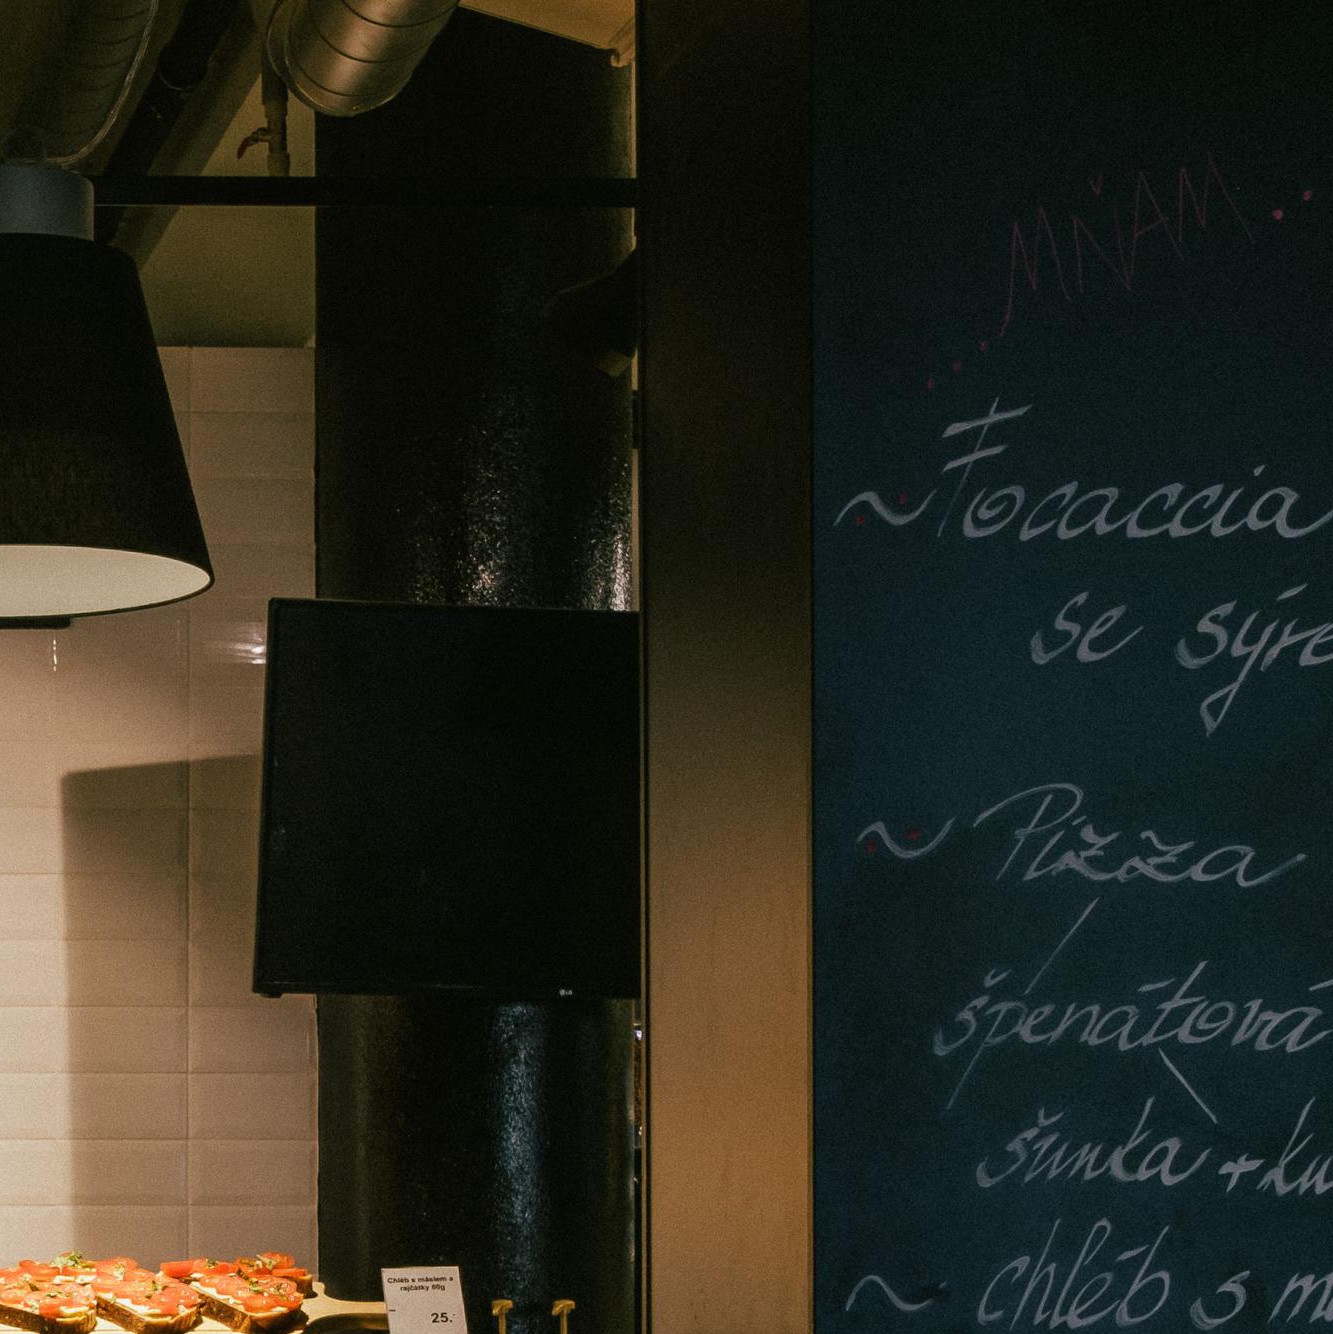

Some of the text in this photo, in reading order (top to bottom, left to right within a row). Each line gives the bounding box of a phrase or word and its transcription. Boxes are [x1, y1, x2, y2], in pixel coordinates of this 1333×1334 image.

[1032, 591, 1144, 664] se
[1190, 1270, 1250, 1331] s
[1268, 1272, 1333, 1324] m
